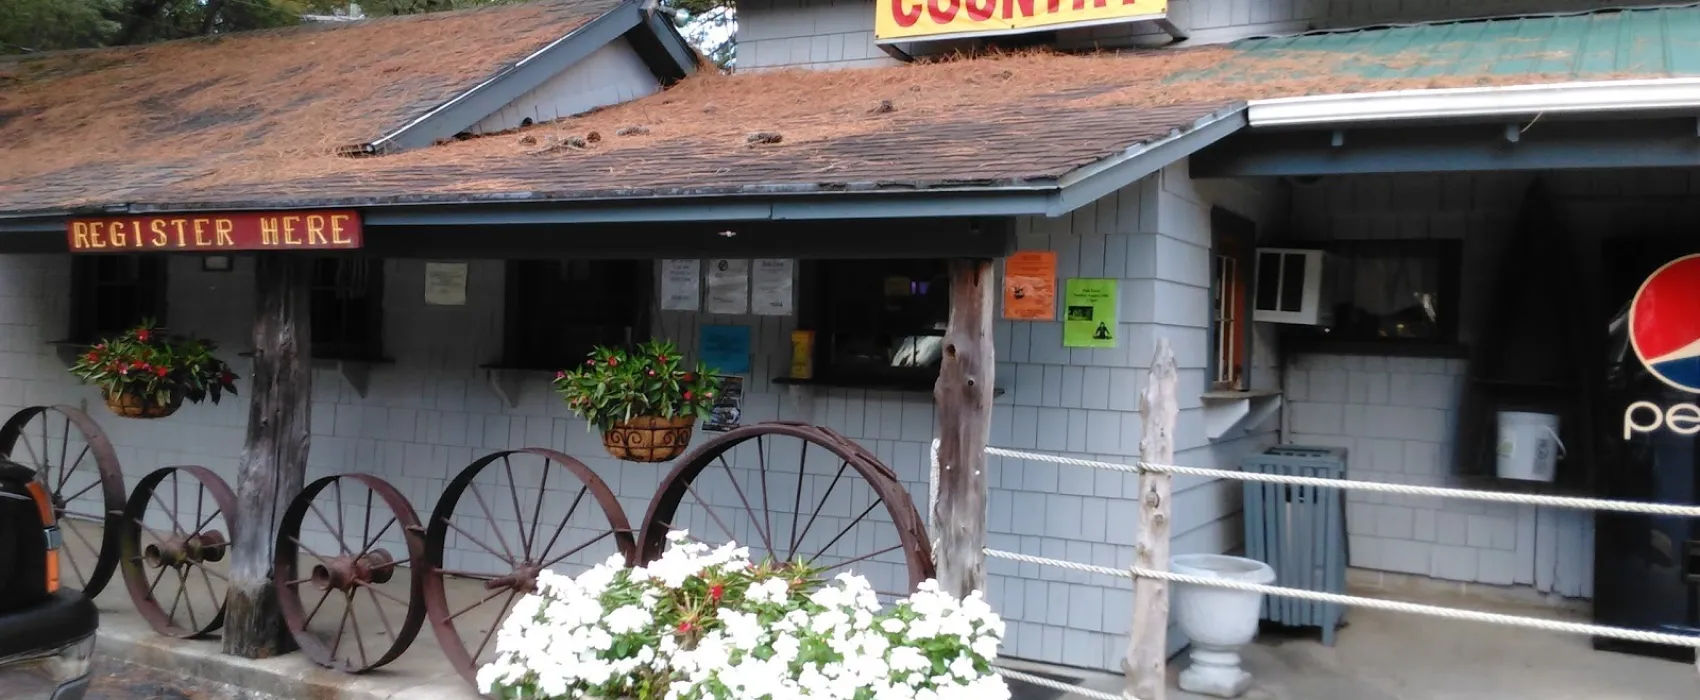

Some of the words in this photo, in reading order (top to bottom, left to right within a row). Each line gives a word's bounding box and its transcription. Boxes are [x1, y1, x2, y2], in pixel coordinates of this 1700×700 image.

[891, 0, 1135, 27] COUN
[73, 218, 234, 249] REGISTER
[260, 214, 352, 246] HERE
